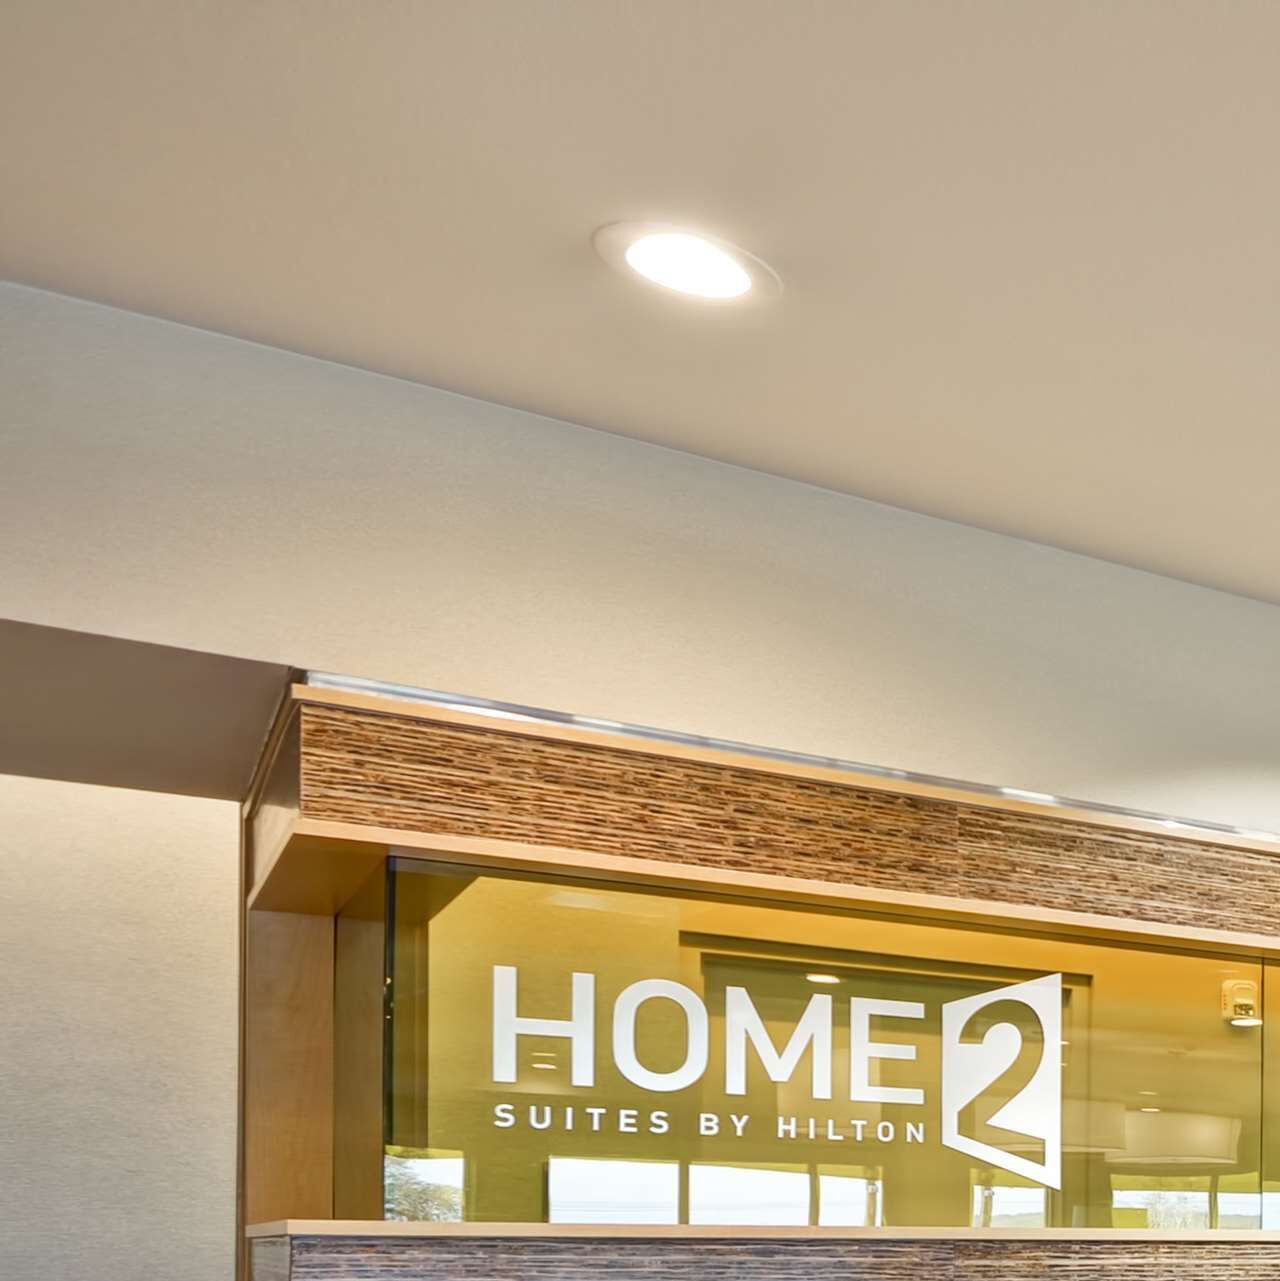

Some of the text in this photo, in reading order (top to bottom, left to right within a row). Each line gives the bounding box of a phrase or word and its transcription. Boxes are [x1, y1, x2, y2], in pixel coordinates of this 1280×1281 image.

[493, 1103, 925, 1144] SUITES BY HILTON
